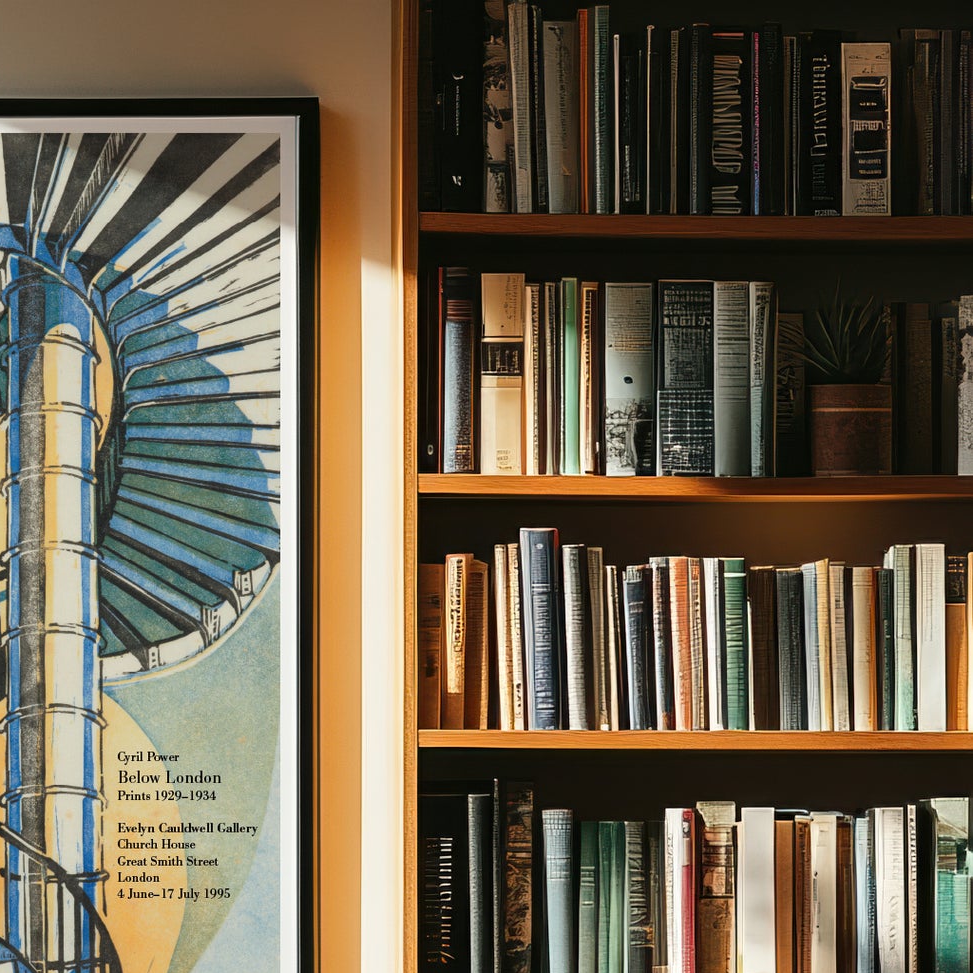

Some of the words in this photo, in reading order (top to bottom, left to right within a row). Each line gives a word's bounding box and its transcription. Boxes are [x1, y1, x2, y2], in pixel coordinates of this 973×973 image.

[117, 751, 143, 765] Cyril
[147, 751, 180, 762] Power
[118, 770, 160, 784] Below
[166, 770, 222, 784] London
[117, 790, 151, 801] Prints
[117, 822, 155, 836] Evelyn
[158, 822, 214, 833] Cauldwell
[217, 822, 258, 836] Gallery
[117, 838, 158, 850] Church
[161, 838, 196, 850] House
[117, 855, 147, 867] Great
[150, 855, 183, 867] Smith
[186, 855, 219, 867] Street
[117, 871, 160, 883] London
[117, 888, 125, 899] 4
[177, 888, 200, 902] July
[204, 888, 231, 900] 1995
